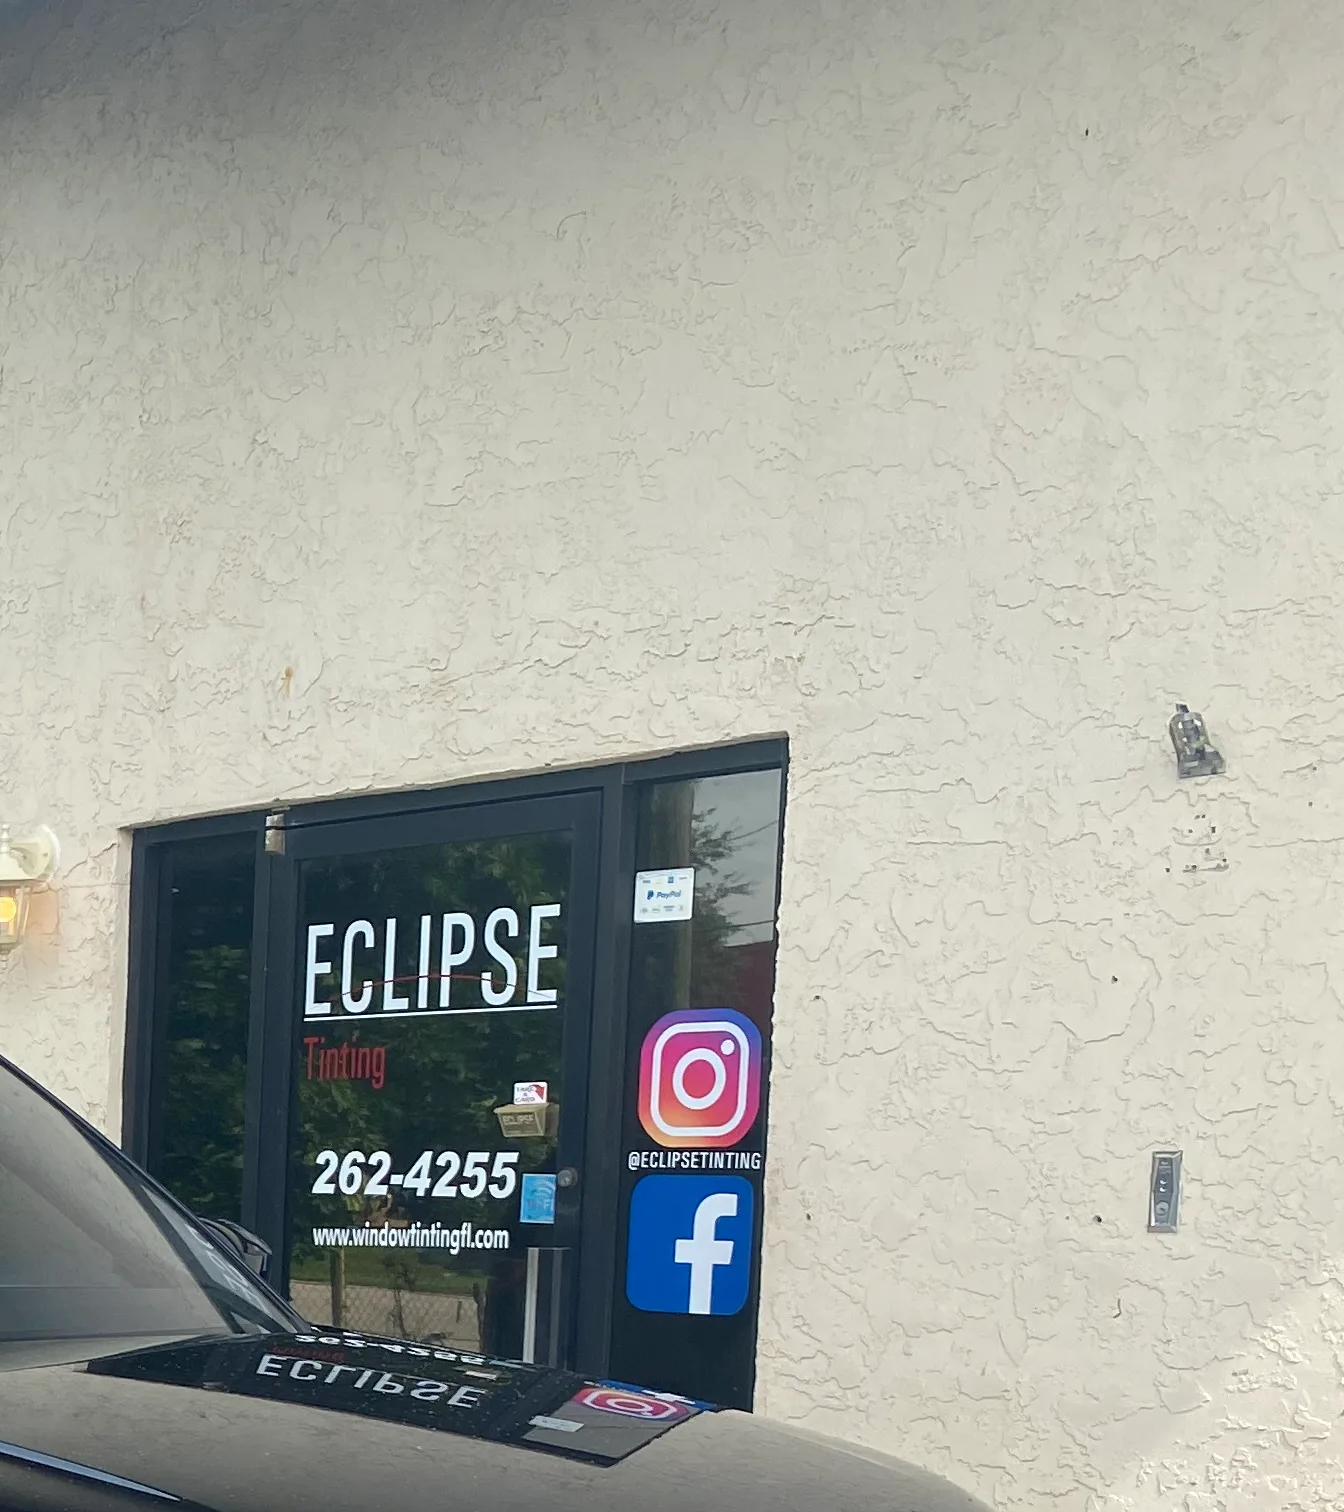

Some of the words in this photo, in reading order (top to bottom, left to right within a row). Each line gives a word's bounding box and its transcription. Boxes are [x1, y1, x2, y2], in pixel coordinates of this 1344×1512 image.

[656, 889, 682, 900] PayPal
[304, 903, 561, 1015] ECLIPSE
[303, 1036, 386, 1089] Tinting
[312, 1150, 519, 1199] 262-4255
[628, 1151, 761, 1171] @ECLIPSETINTING
[313, 1220, 509, 1255] www.windowtintingfl.com
